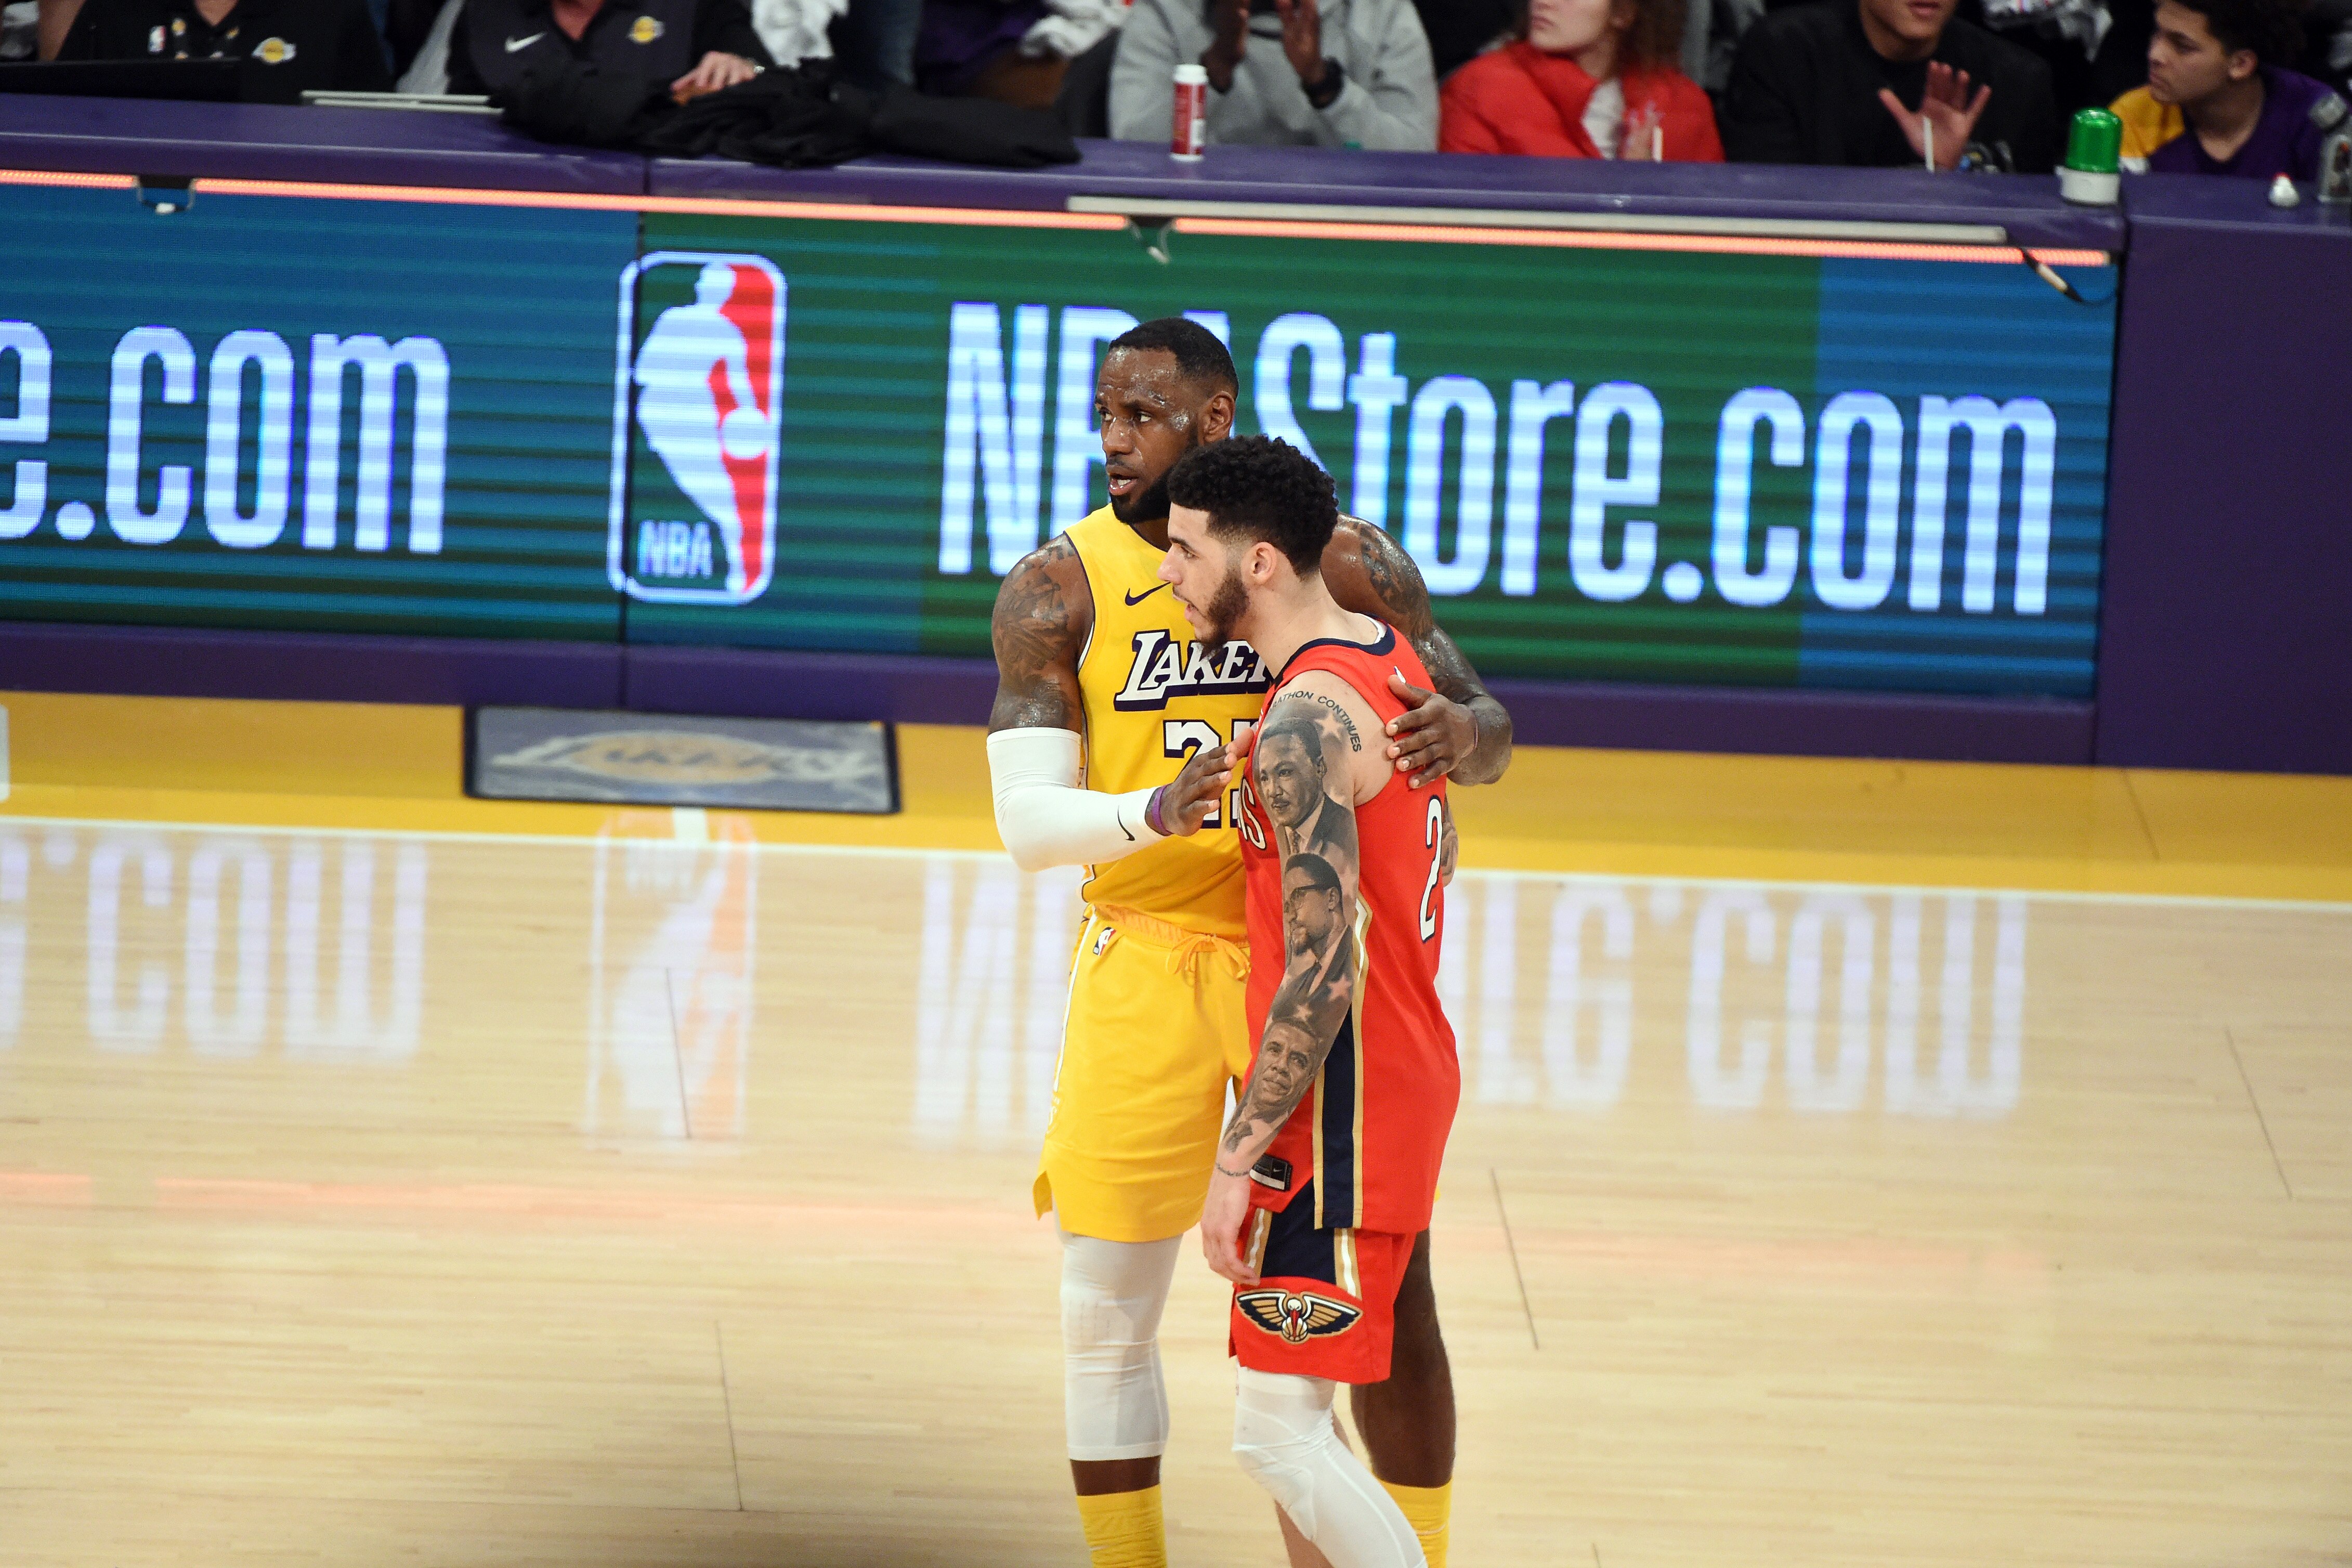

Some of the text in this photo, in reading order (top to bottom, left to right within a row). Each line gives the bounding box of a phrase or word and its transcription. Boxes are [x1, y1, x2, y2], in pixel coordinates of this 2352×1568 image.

[938, 302, 2057, 615] NBStore.com
[637, 519, 713, 579] NBA
[1317, 696, 1362, 752] CONTINUES
[1419, 795, 1443, 943] 2
